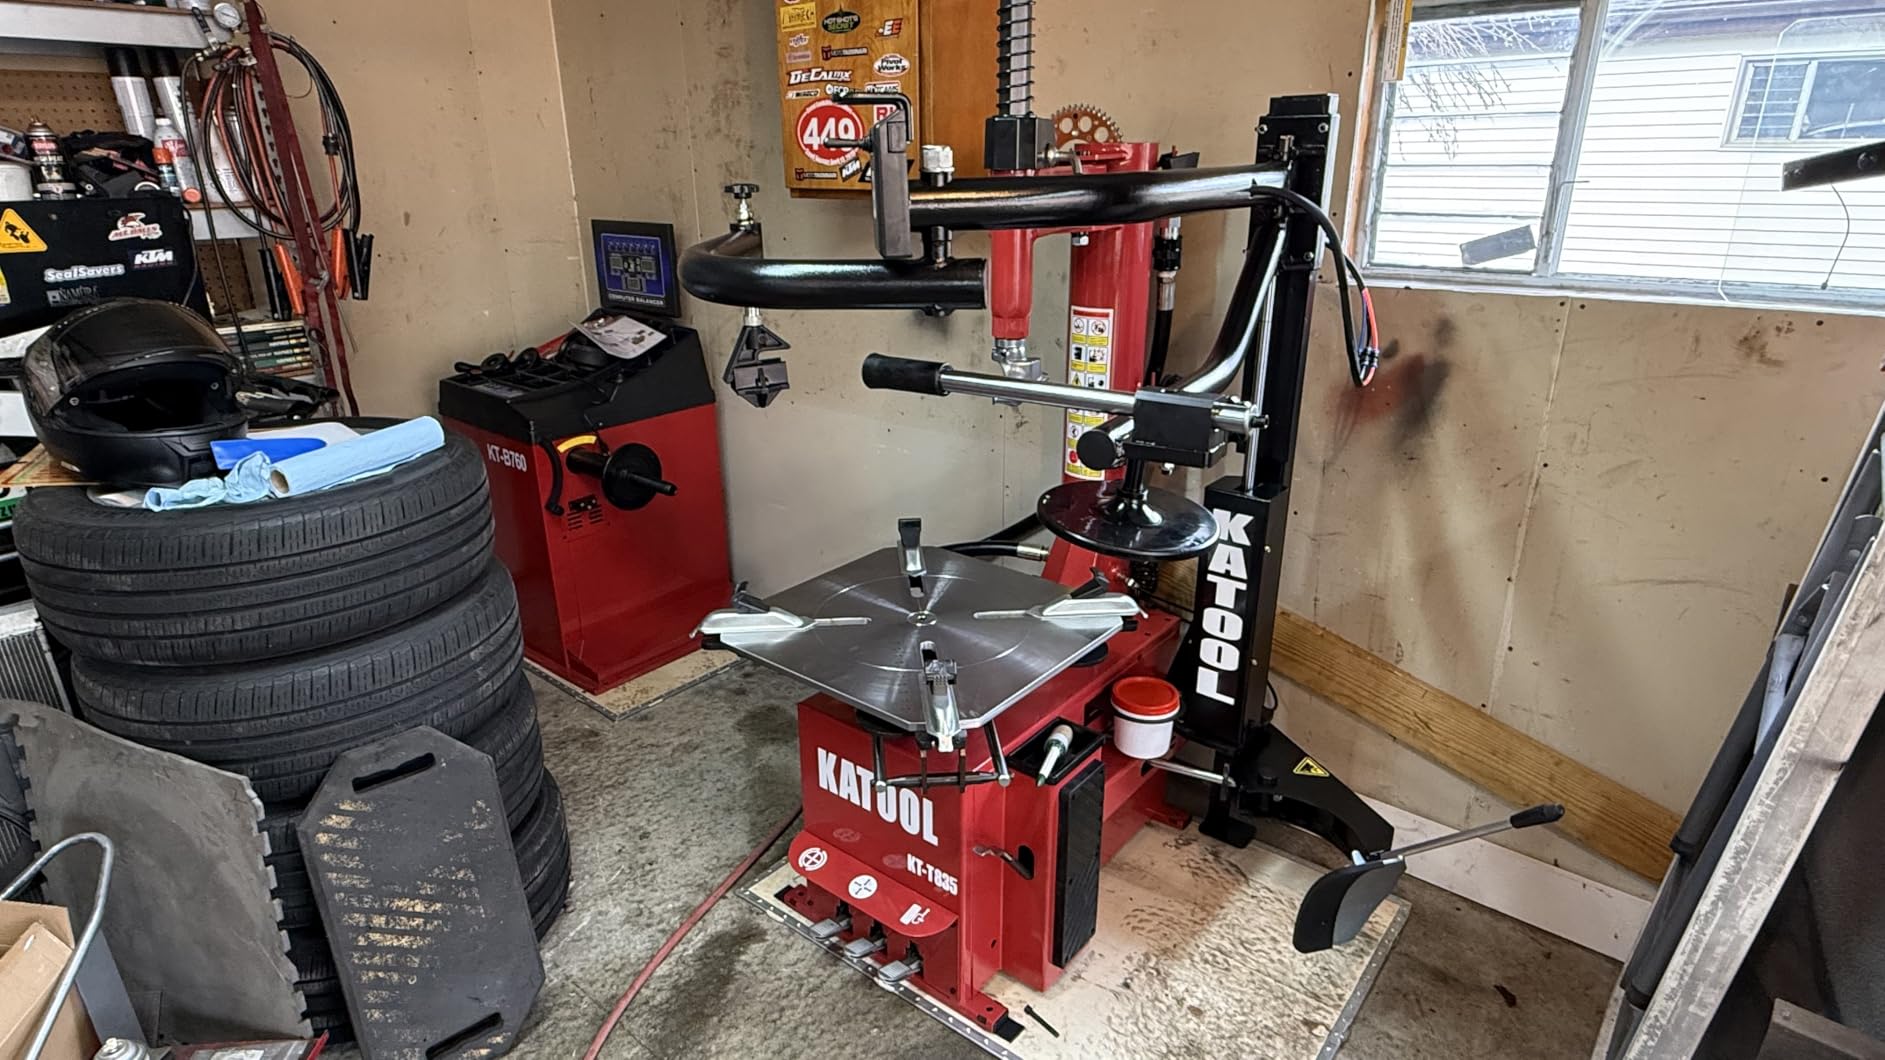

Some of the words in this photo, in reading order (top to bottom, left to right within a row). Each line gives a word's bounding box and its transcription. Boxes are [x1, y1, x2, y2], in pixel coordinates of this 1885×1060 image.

[877, 63, 908, 72] Works
[880, 57, 904, 66] Pivot
[134, 249, 174, 265] KTM
[46, 264, 124, 282] SealSavers
[487, 443, 528, 473] KT-B760
[1195, 507, 1255, 706] KATOOL
[817, 747, 940, 847] KATOOL
[906, 853, 959, 897] KT-T835
